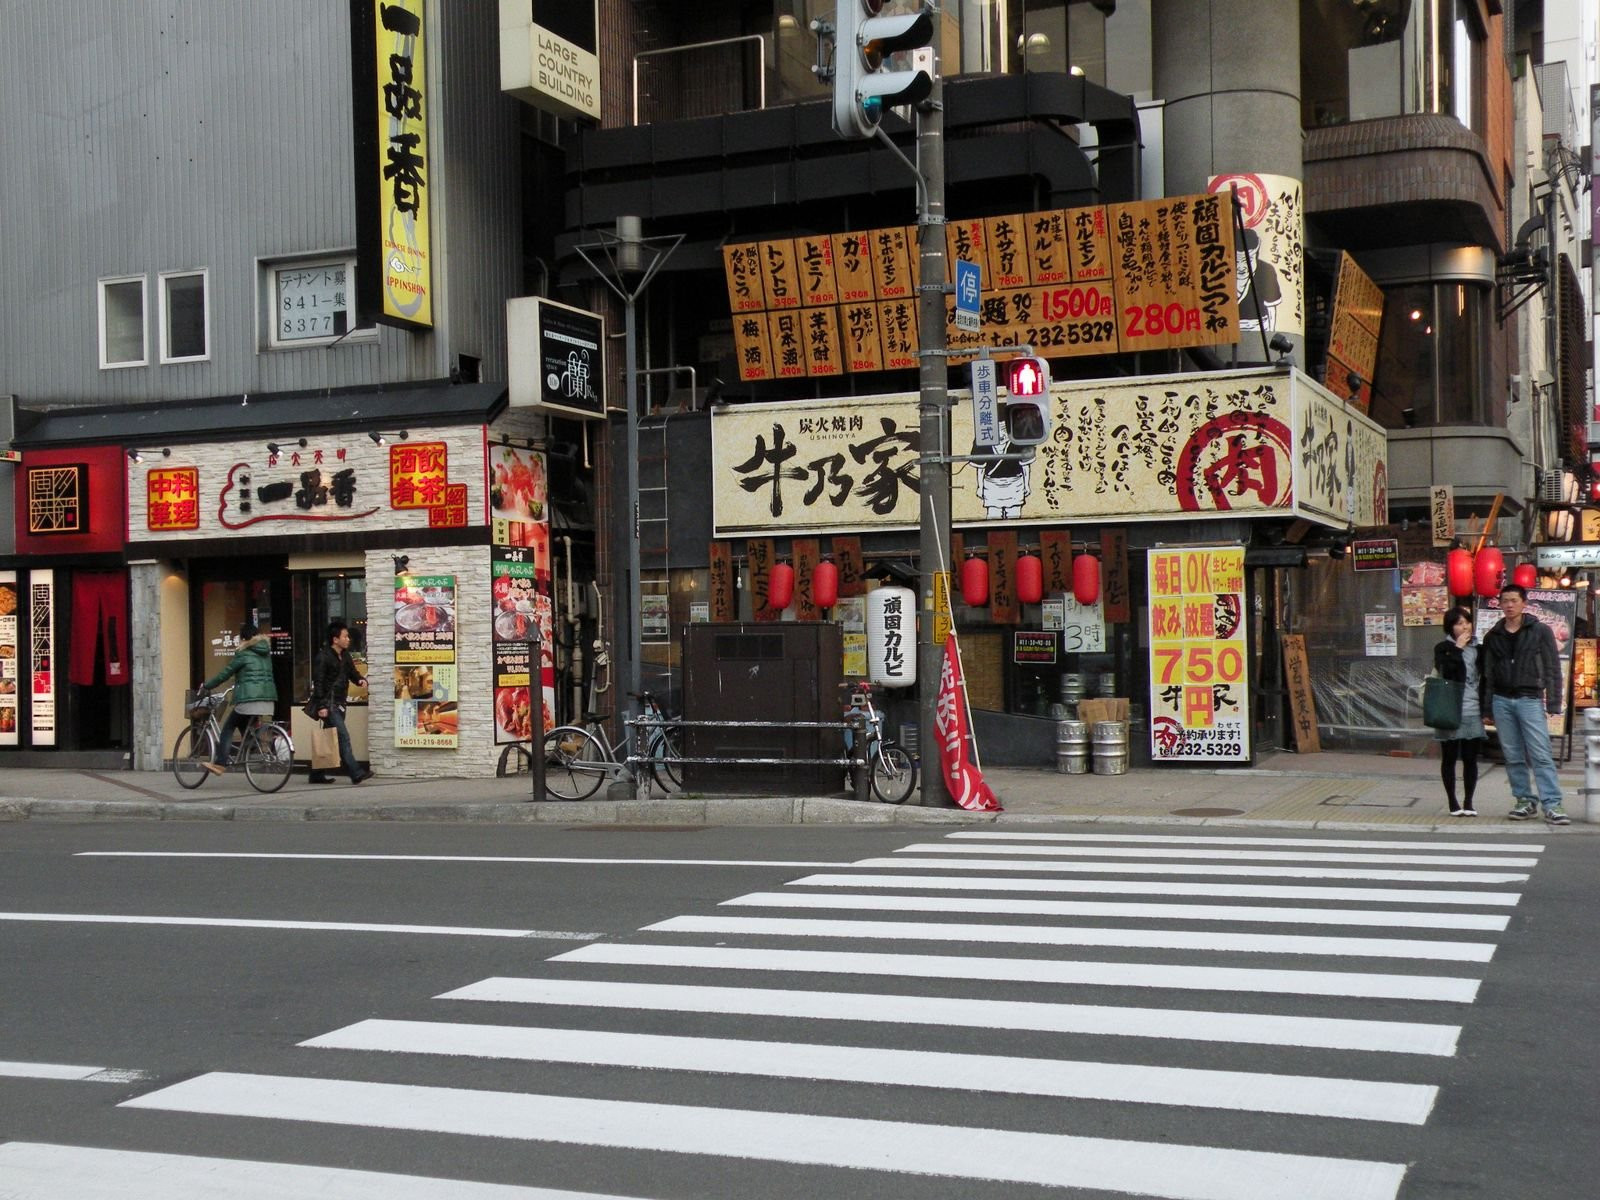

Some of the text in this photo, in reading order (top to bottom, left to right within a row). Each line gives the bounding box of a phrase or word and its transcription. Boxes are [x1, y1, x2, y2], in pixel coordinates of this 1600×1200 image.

[538, 33, 578, 66] LARGE
[538, 53, 593, 89] COUNTRY
[539, 71, 594, 108] BUILDING
[380, 2, 425, 221] 一品香
[385, 240, 426, 260] CHINESE DINING
[842, 236, 860, 272] ガツ
[879, 232, 896, 286] 牛ホルモン
[995, 220, 1017, 275] 牛サガリ
[1076, 211, 1096, 267] ホルモン
[281, 271, 332, 290] テナント
[731, 248, 750, 297] なんこつ
[767, 245, 787, 297] トントロ
[803, 241, 824, 291] 上ミノ
[1192, 197, 1230, 335] 頑固カルビつくね
[960, 270, 977, 303] 停
[283, 316, 331, 333] 8377
[848, 308, 864, 352] サワー
[895, 303, 912, 353] 生ビール
[991, 321, 1114, 347] tel 232-5329
[1125, 303, 1201, 337] 280円
[742, 319, 761, 364] 梅酒
[778, 316, 799, 366] 日本酒
[977, 365, 994, 441] 歩車分離式
[800, 415, 863, 434] 炭火焼肉
[810, 433, 857, 441] USHINOYA
[1155, 553, 1212, 594] 毎日 OK
[884, 596, 904, 677] 頑固カルビ
[1152, 603, 1214, 637] 飲み放題
[1155, 647, 1243, 684] 750
[1186, 686, 1214, 726] 円
[1176, 729, 1241, 741] 予約承ります!
